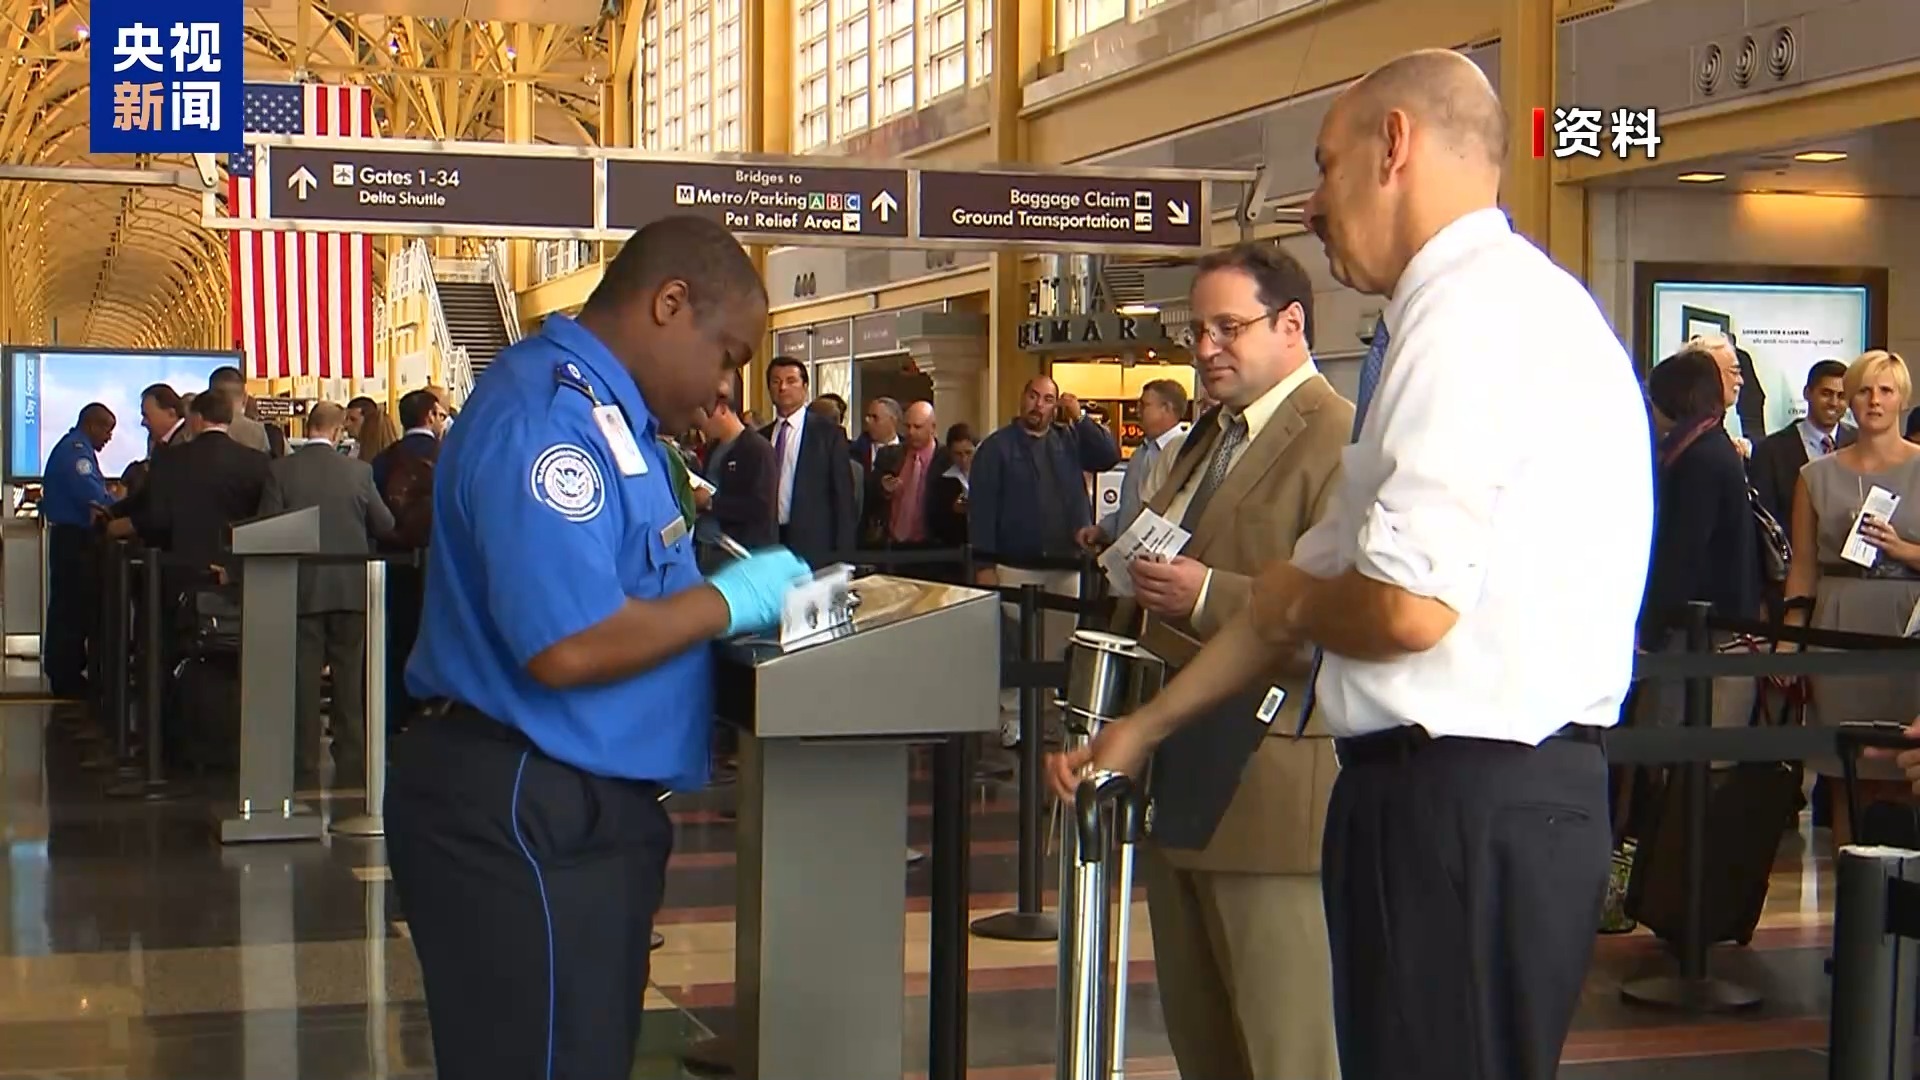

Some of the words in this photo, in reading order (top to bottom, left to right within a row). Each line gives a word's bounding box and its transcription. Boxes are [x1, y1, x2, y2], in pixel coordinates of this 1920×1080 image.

[359, 167, 412, 186] Gates
[418, 168, 460, 187] 1-34
[735, 170, 784, 186] Bridges
[789, 172, 802, 184] to
[359, 190, 396, 205] Delta
[399, 191, 446, 206] Shuttle
[697, 189, 807, 210] Metro/Parking
[1010, 189, 1080, 209] Baggage
[1084, 191, 1130, 208] Claim
[725, 212, 749, 227] Pet
[755, 213, 799, 229] Relief
[804, 215, 842, 230] Area
[952, 208, 1013, 226] Ground
[1017, 210, 1130, 230] Transportation
